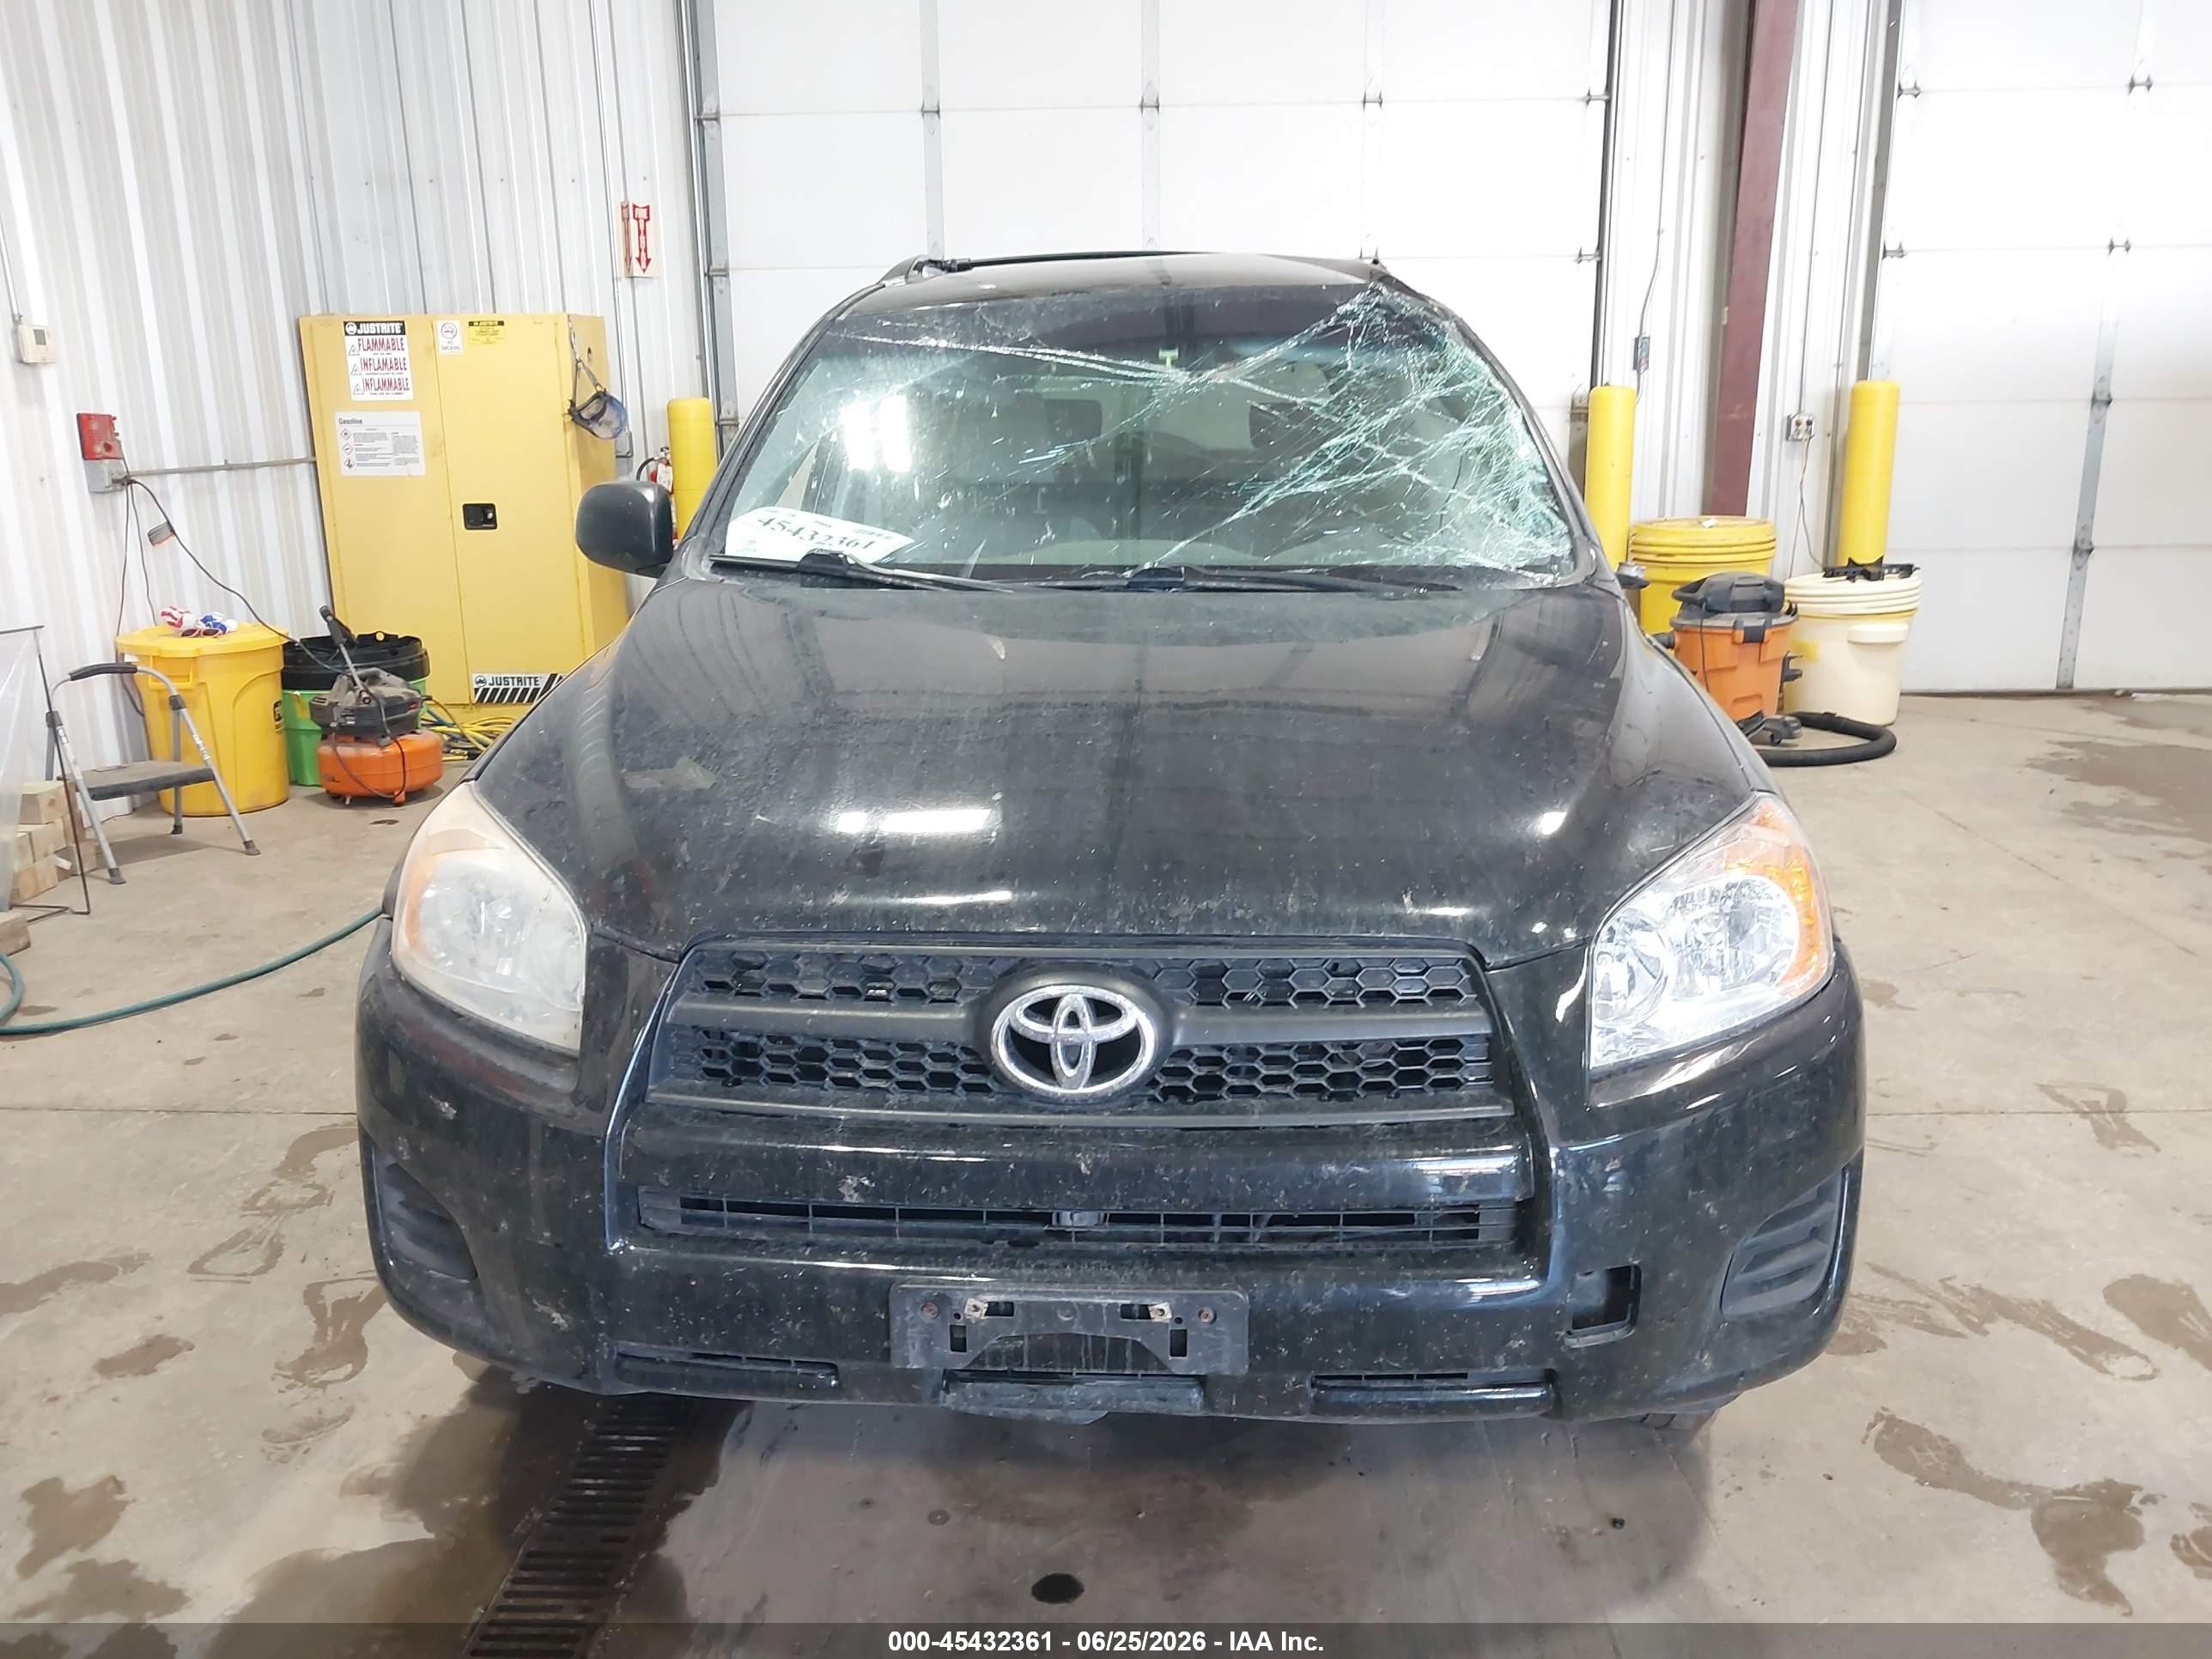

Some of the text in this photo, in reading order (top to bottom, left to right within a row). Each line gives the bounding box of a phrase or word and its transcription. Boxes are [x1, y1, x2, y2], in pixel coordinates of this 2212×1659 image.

[357, 323, 402, 335] JUSTRITE
[357, 337, 405, 352] FLAMMABLE
[360, 357, 408, 372] INFLAMABLE
[362, 378, 410, 392] INFLAMMABLE
[757, 517, 877, 550] 45432361
[489, 677, 540, 686] JUSTRITE
